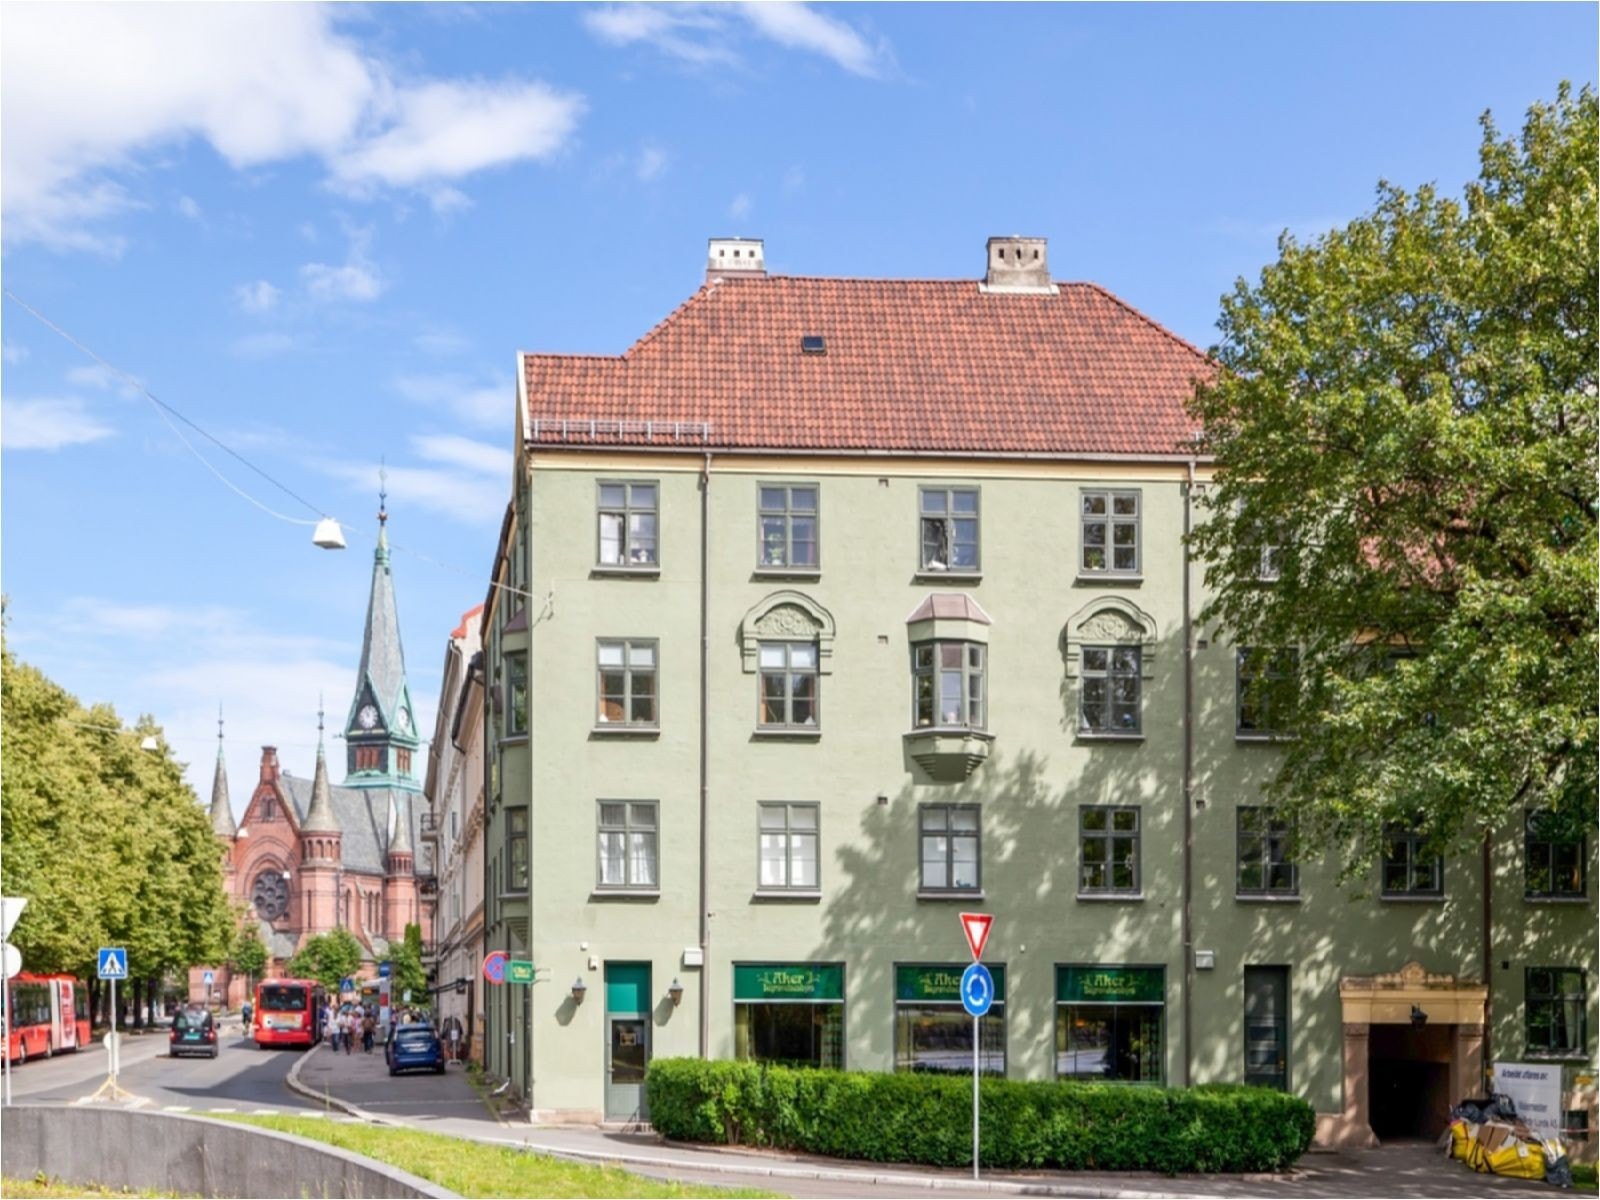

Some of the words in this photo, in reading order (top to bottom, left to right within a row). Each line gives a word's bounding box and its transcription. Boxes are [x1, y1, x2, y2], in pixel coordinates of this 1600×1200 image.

[773, 971, 805, 984] Aker
[934, 973, 960, 985] Ake
[1094, 973, 1125, 986] Aker
